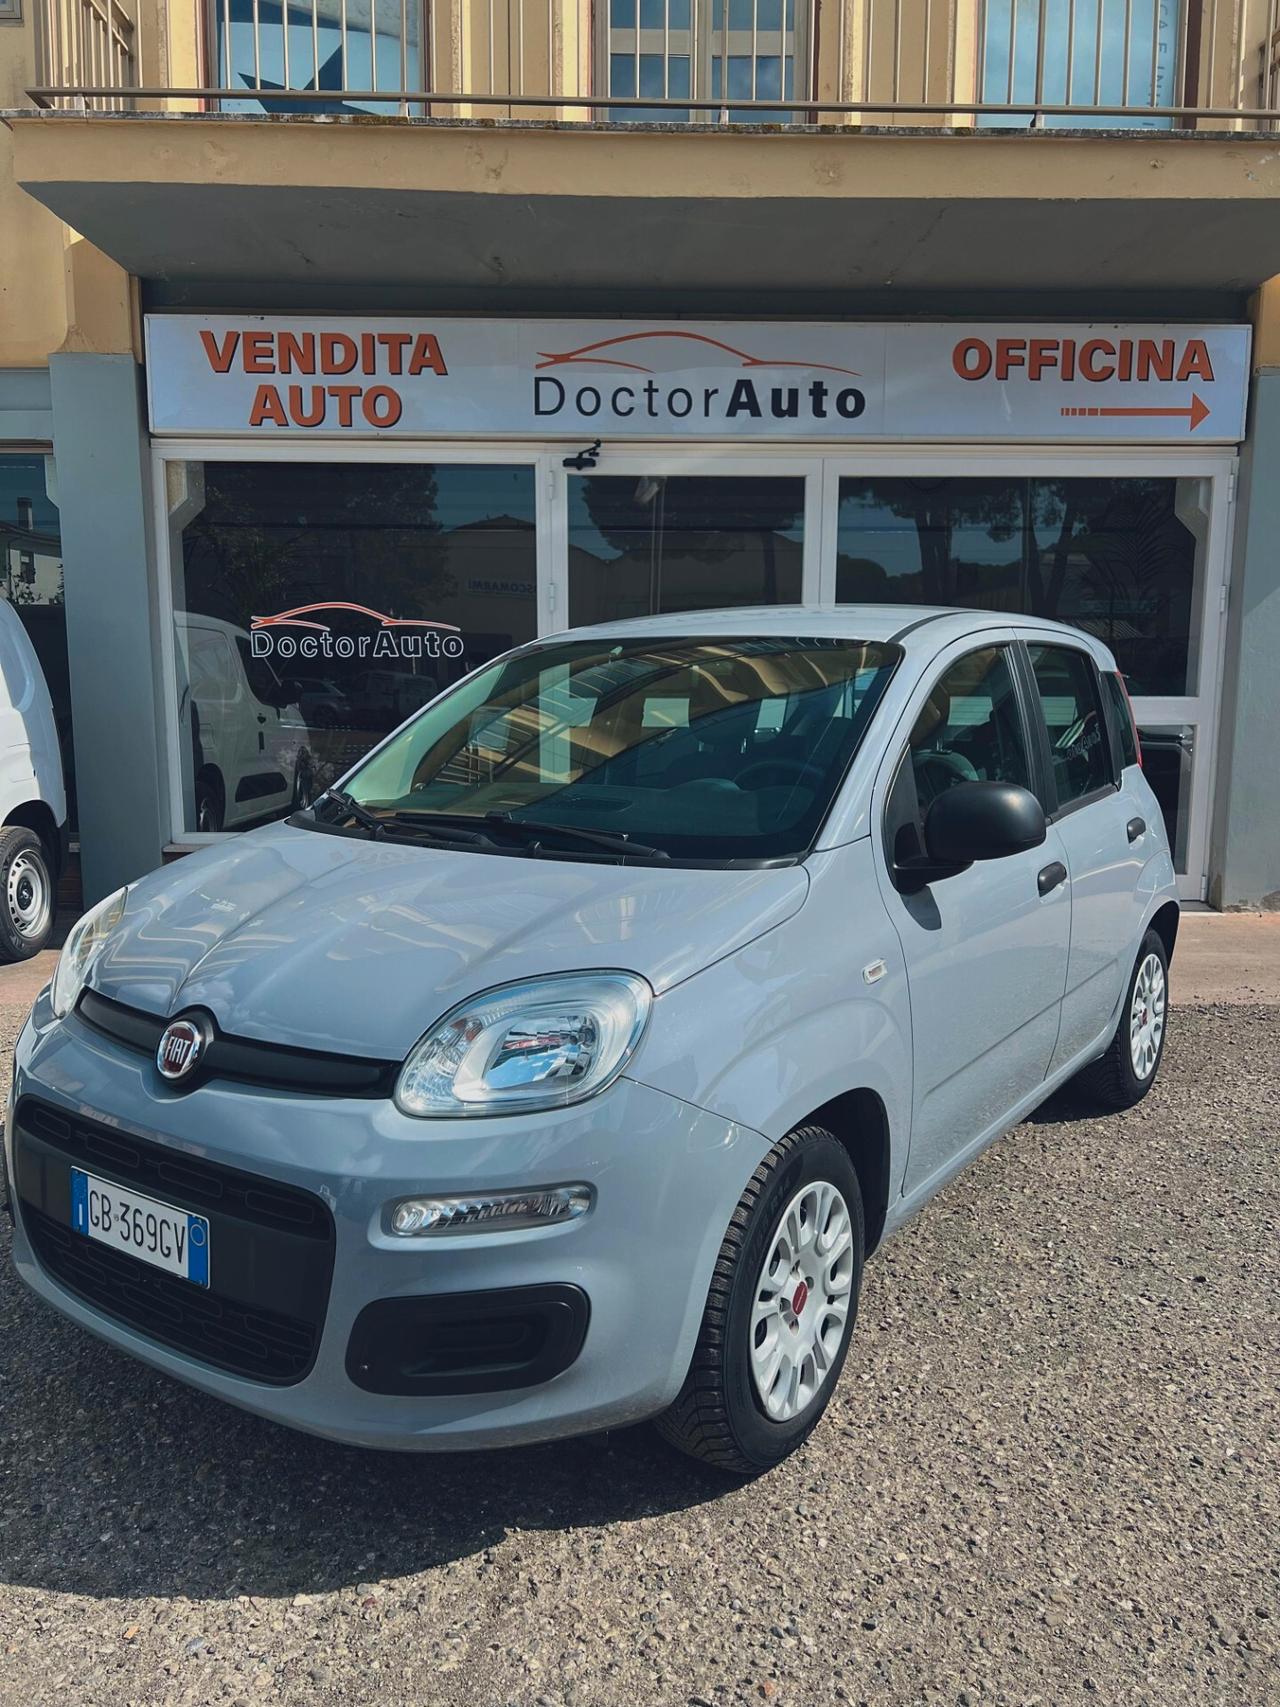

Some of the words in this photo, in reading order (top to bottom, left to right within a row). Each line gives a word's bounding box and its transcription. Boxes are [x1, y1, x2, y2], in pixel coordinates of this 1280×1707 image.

[199, 331, 448, 375] VENDITA
[952, 338, 1215, 382] OFFICINA
[249, 384, 402, 428] AUTO
[533, 376, 866, 419] DoctorAuto
[251, 630, 464, 658] DoctorAuto
[164, 1036, 192, 1064] FIAT
